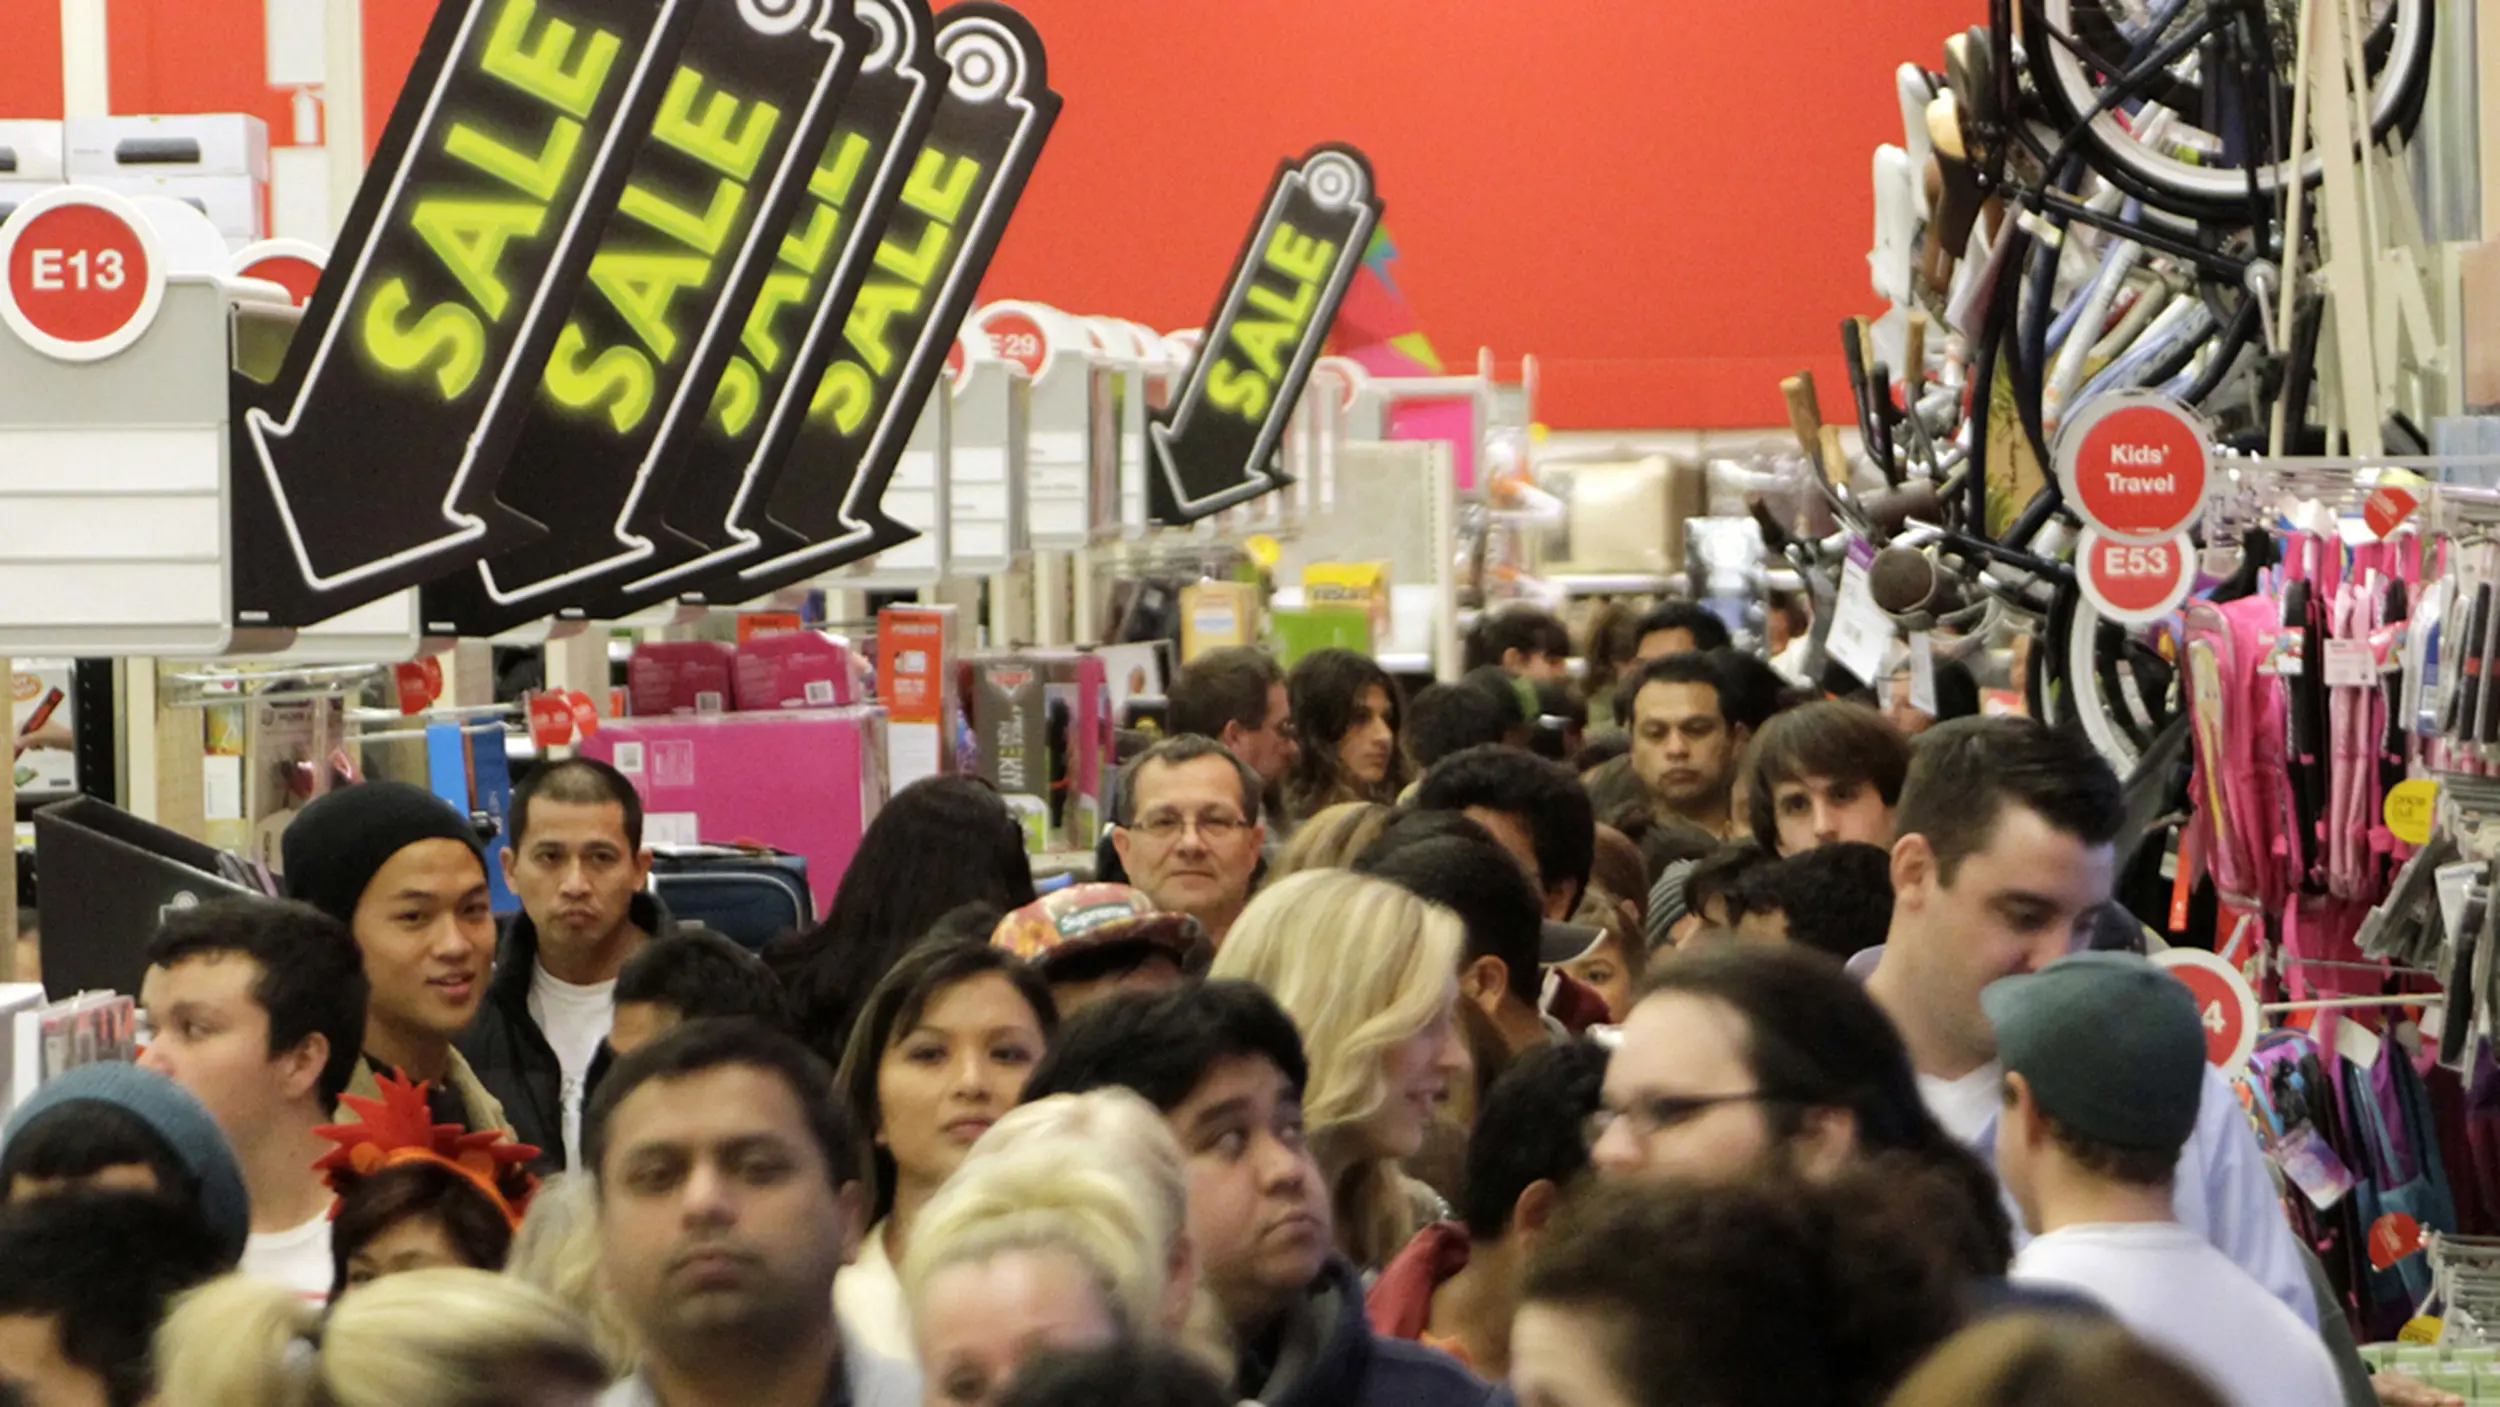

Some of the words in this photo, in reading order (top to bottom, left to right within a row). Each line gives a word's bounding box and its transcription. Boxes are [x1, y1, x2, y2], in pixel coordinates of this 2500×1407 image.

[544, 66, 780, 433] SALE
[32, 249, 126, 290] E13
[808, 147, 981, 437] SALE
[1206, 222, 1337, 422] SALE
[990, 333, 1036, 357] E29
[2110, 443, 2170, 465] Kids'
[2103, 471, 2175, 494] Travel
[2104, 547, 2168, 576] E53
